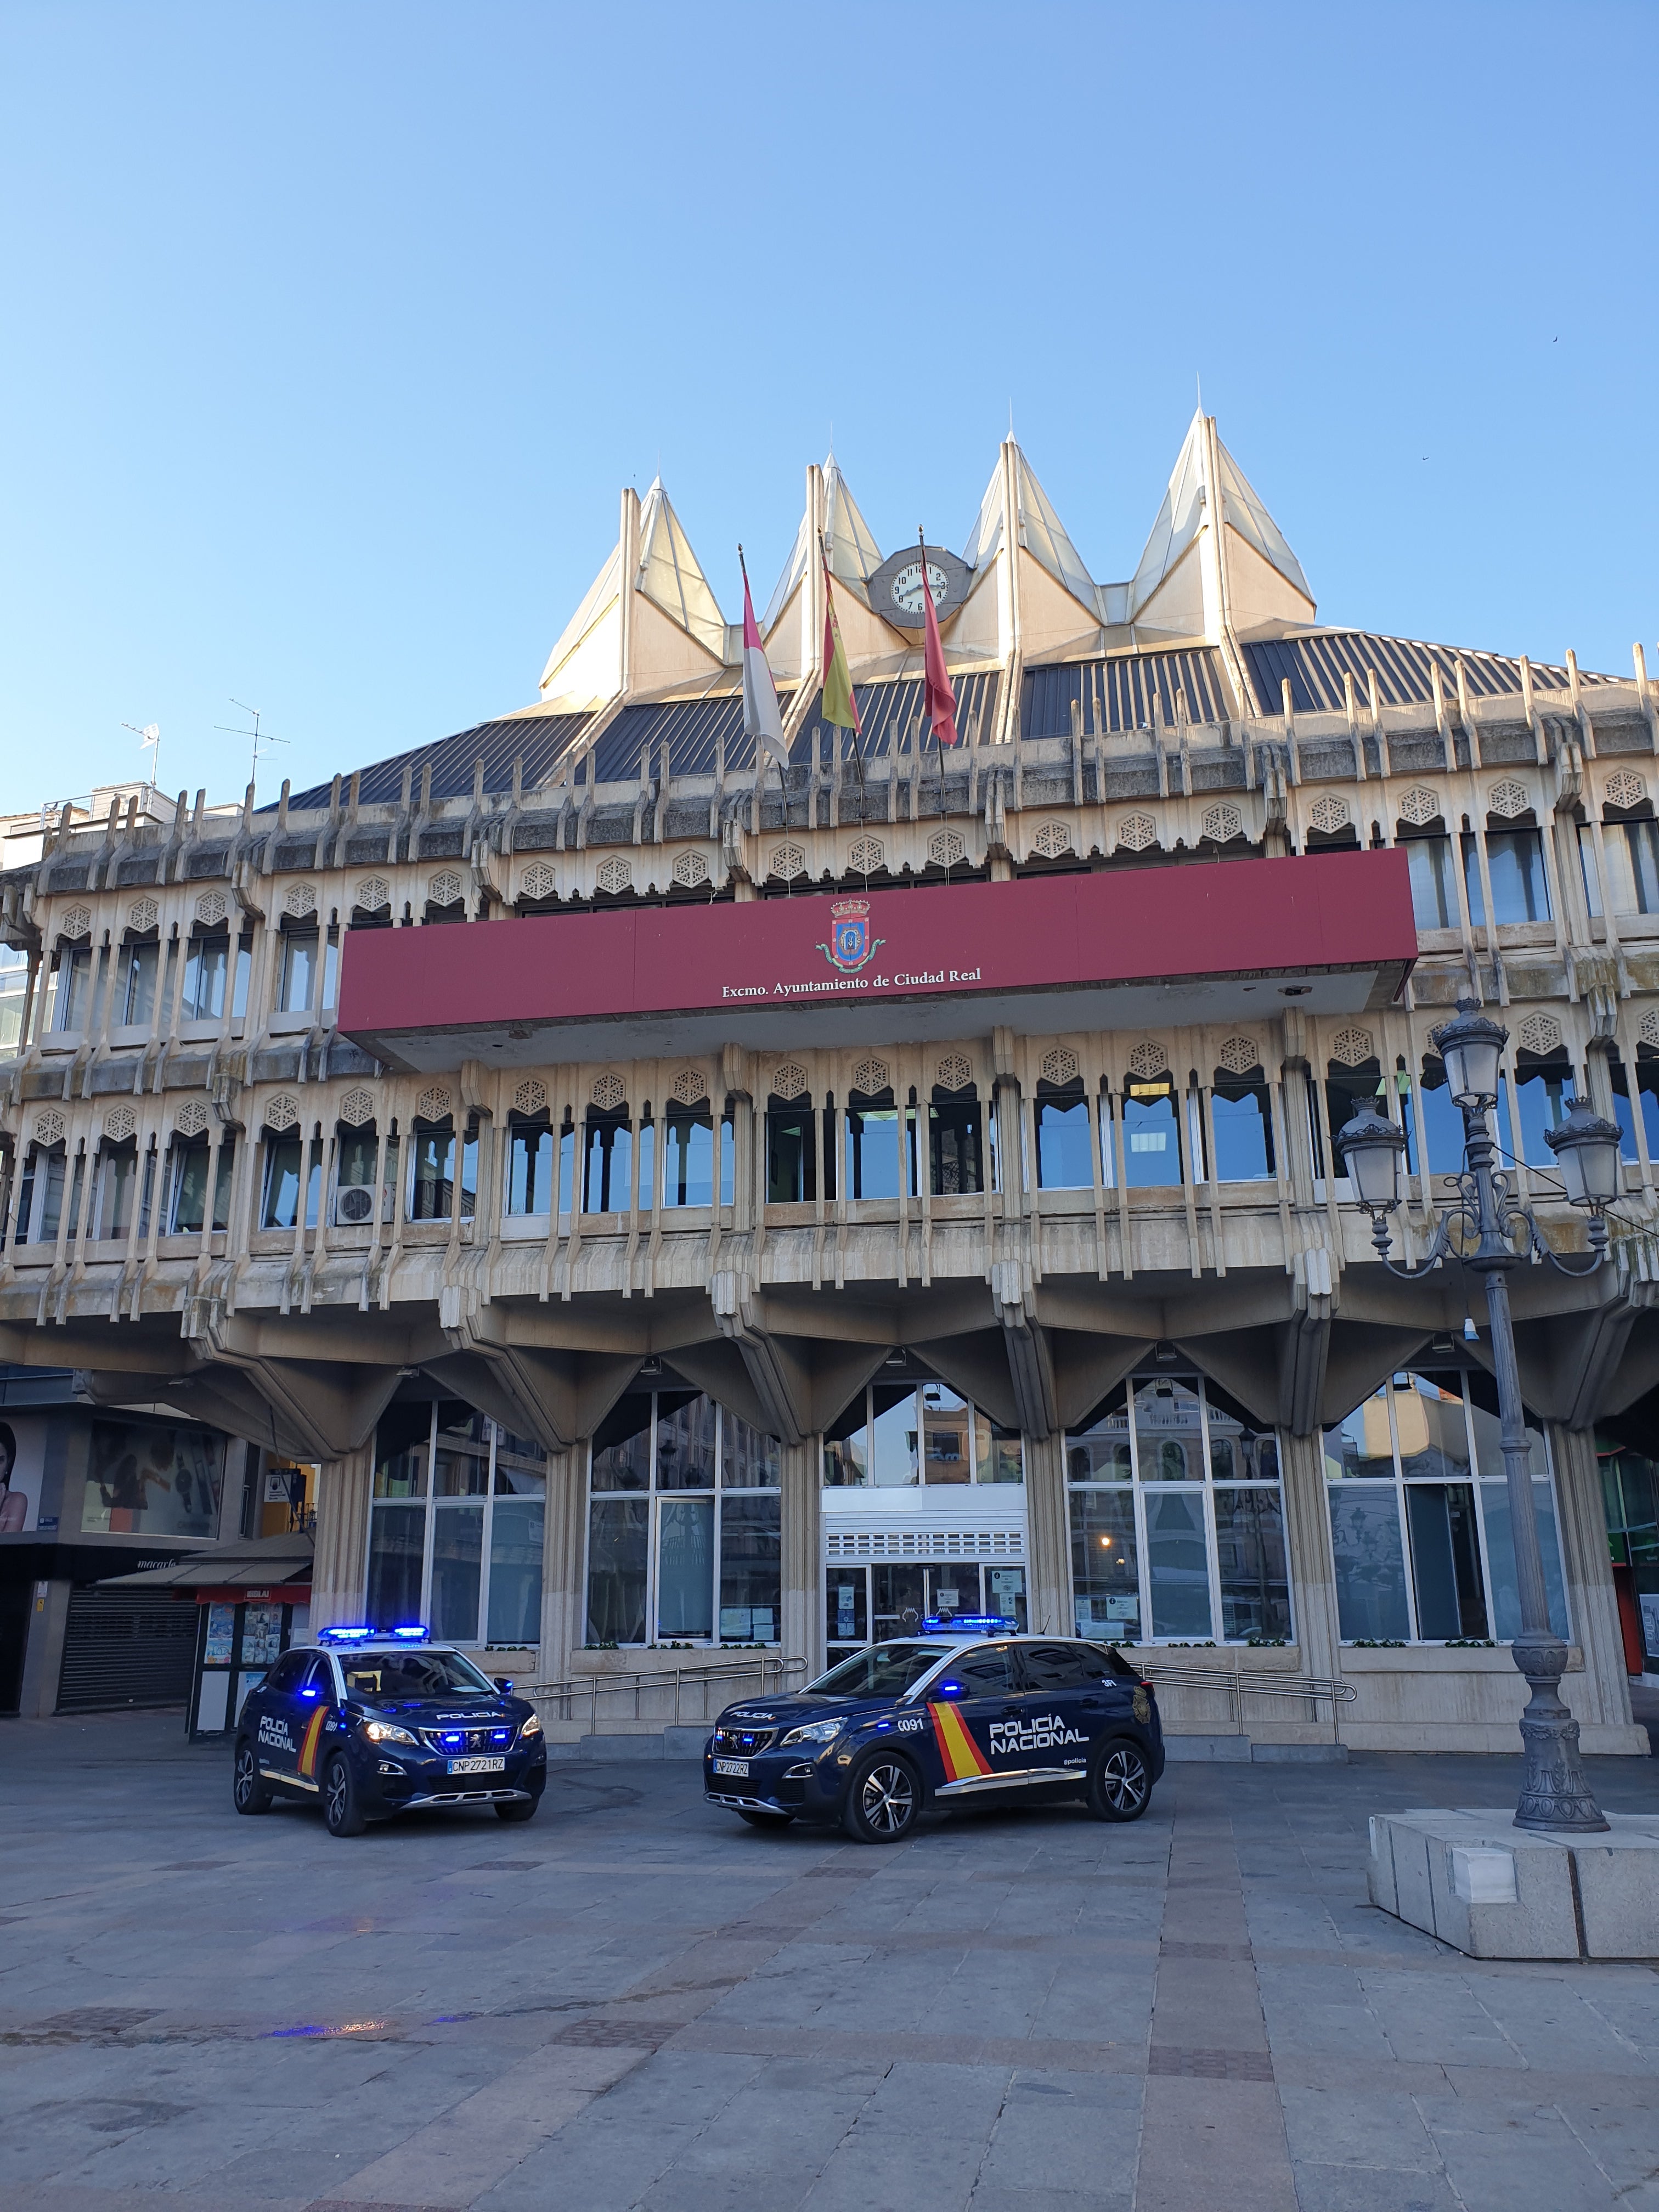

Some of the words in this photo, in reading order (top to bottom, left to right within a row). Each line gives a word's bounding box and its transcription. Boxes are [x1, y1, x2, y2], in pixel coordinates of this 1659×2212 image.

[898, 577, 906, 585] 10
[936, 573, 941, 581] 2
[894, 586, 900, 594] 9
[940, 582, 945, 590] 3
[936, 591, 942, 599] 4
[907, 601, 913, 610] 7
[917, 603, 923, 611] 6
[722, 986, 769, 997] Excmo.
[772, 977, 868, 997] Ayuntamiento
[873, 975, 890, 987] de
[894, 970, 945, 986] Ciudad
[949, 968, 981, 982] Real
[989, 1713, 1065, 1739] POLICÍA
[258, 1729, 297, 1753] NACIONAL
[991, 1728, 1090, 1755] NACIONAL
